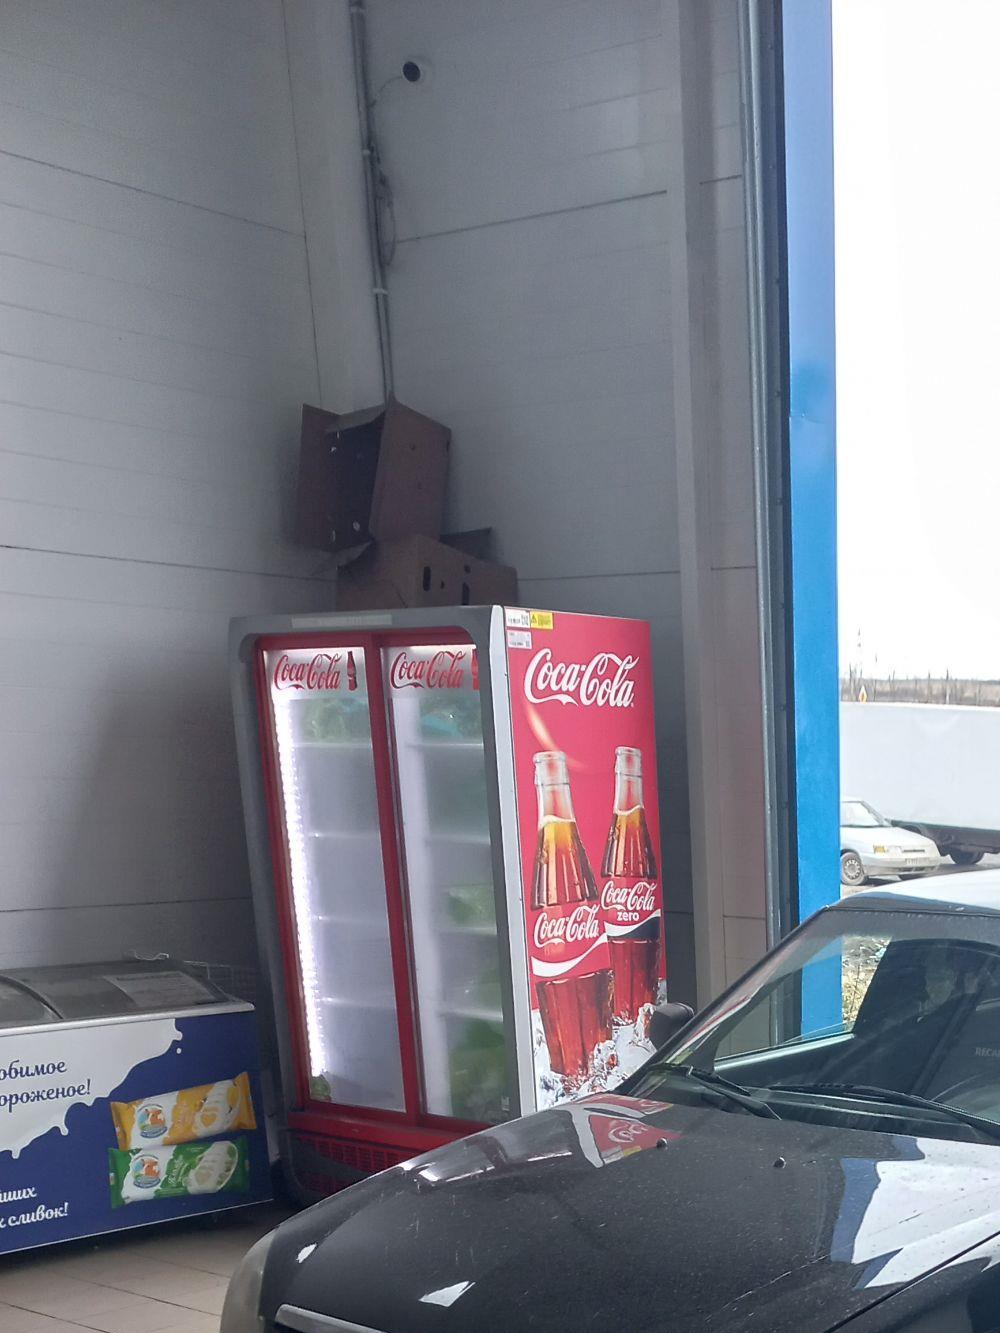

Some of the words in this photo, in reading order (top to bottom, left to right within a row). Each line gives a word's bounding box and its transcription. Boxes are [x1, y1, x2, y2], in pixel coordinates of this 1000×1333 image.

[274, 653, 342, 690] Coca-Cola
[390, 651, 466, 690] Coca-Cola
[524, 648, 639, 707] Coca-Cola
[601, 880, 657, 911] Coca-Cola
[534, 904, 600, 948] Coca-Cola
[617, 911, 640, 922] zero
[8, 1202, 69, 1227] сливок!
